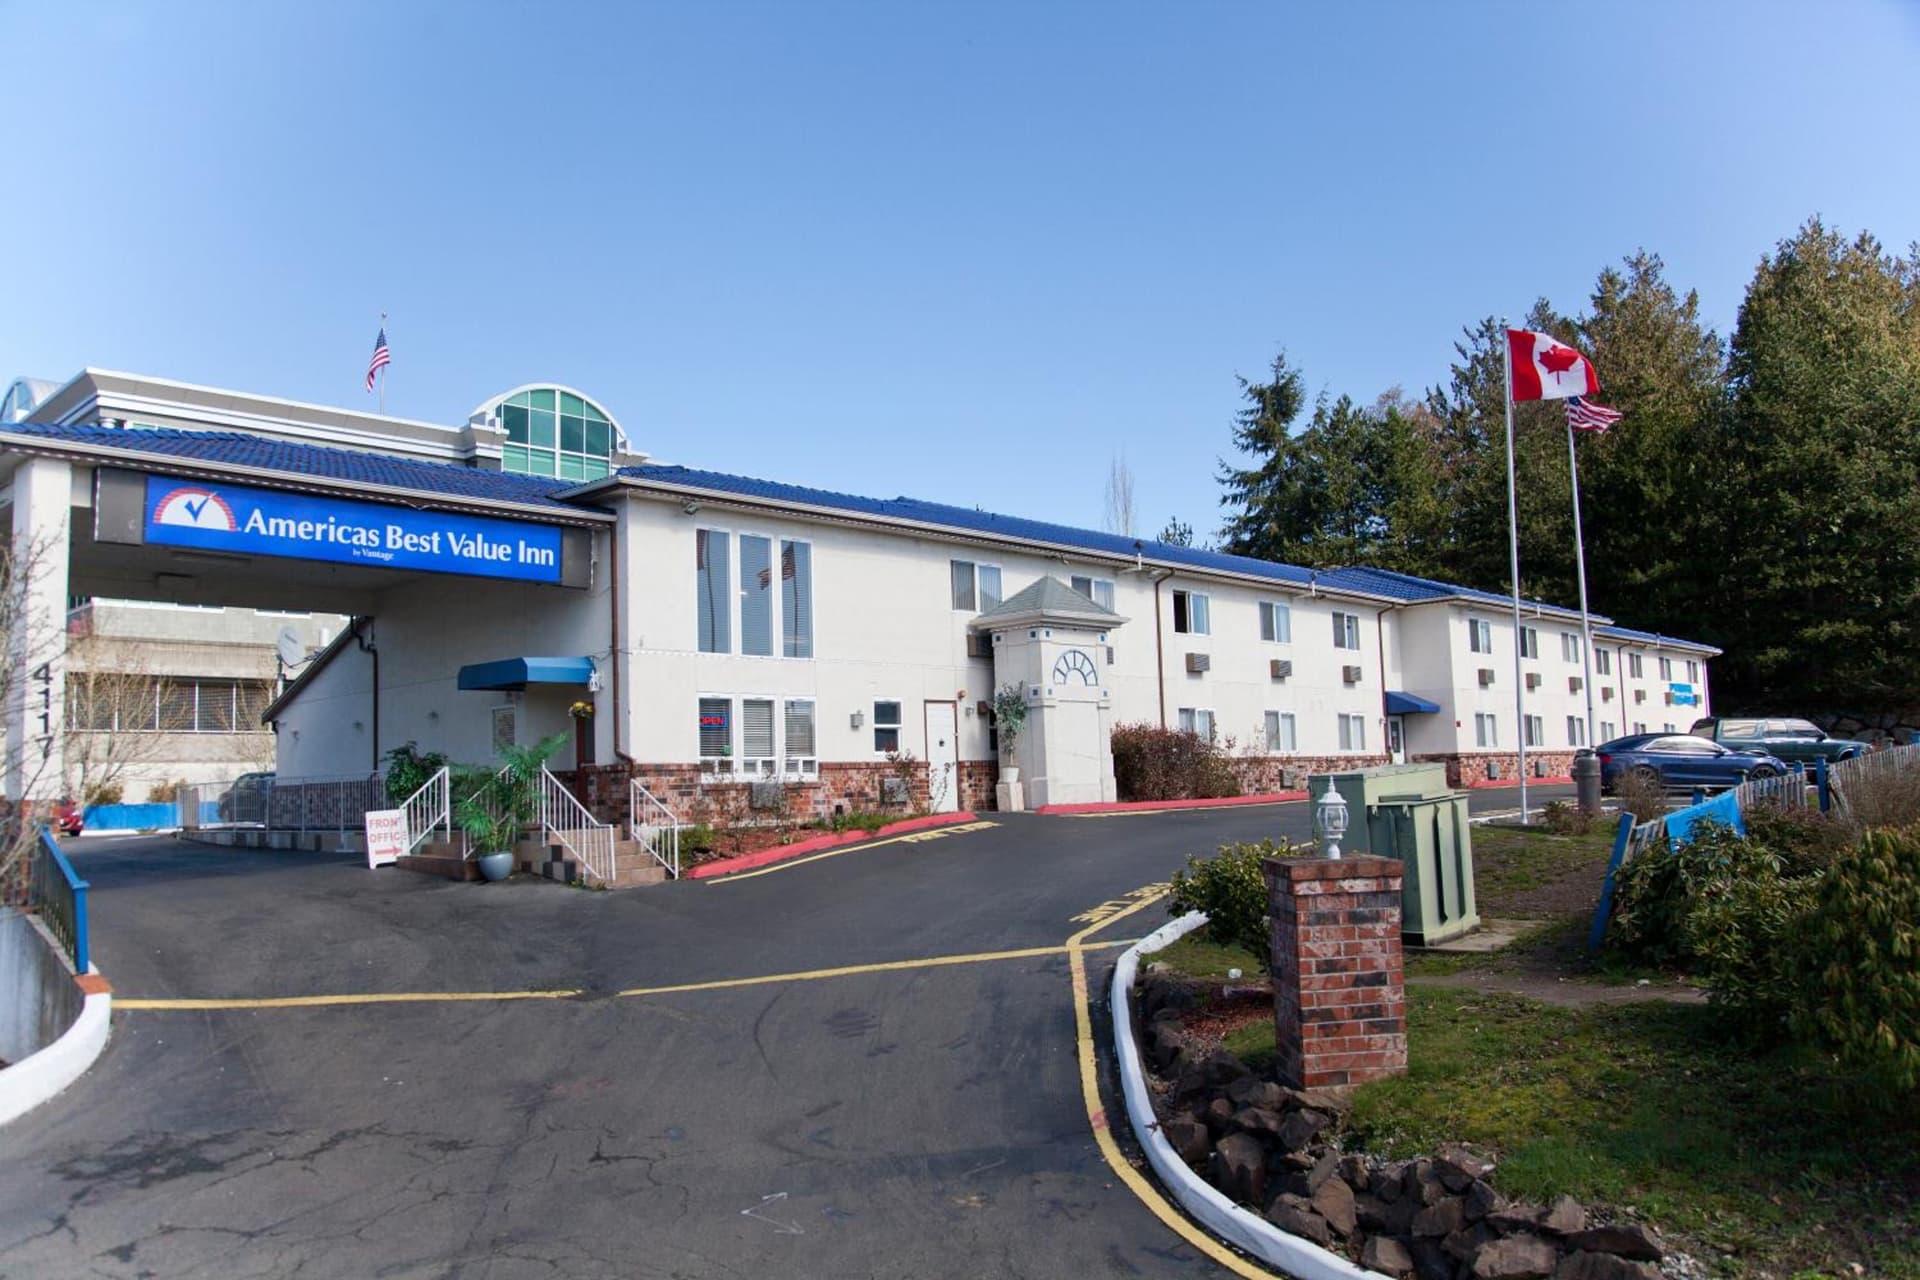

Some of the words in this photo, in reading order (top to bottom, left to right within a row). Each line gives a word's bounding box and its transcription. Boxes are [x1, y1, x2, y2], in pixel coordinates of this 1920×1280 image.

[244, 508, 380, 547] Americas
[385, 525, 441, 554] Best
[447, 532, 512, 562] Value
[518, 540, 555, 567] Inn
[362, 549, 395, 562] Vantage
[33, 664, 54, 760] 4117
[368, 816, 405, 829] FRON
